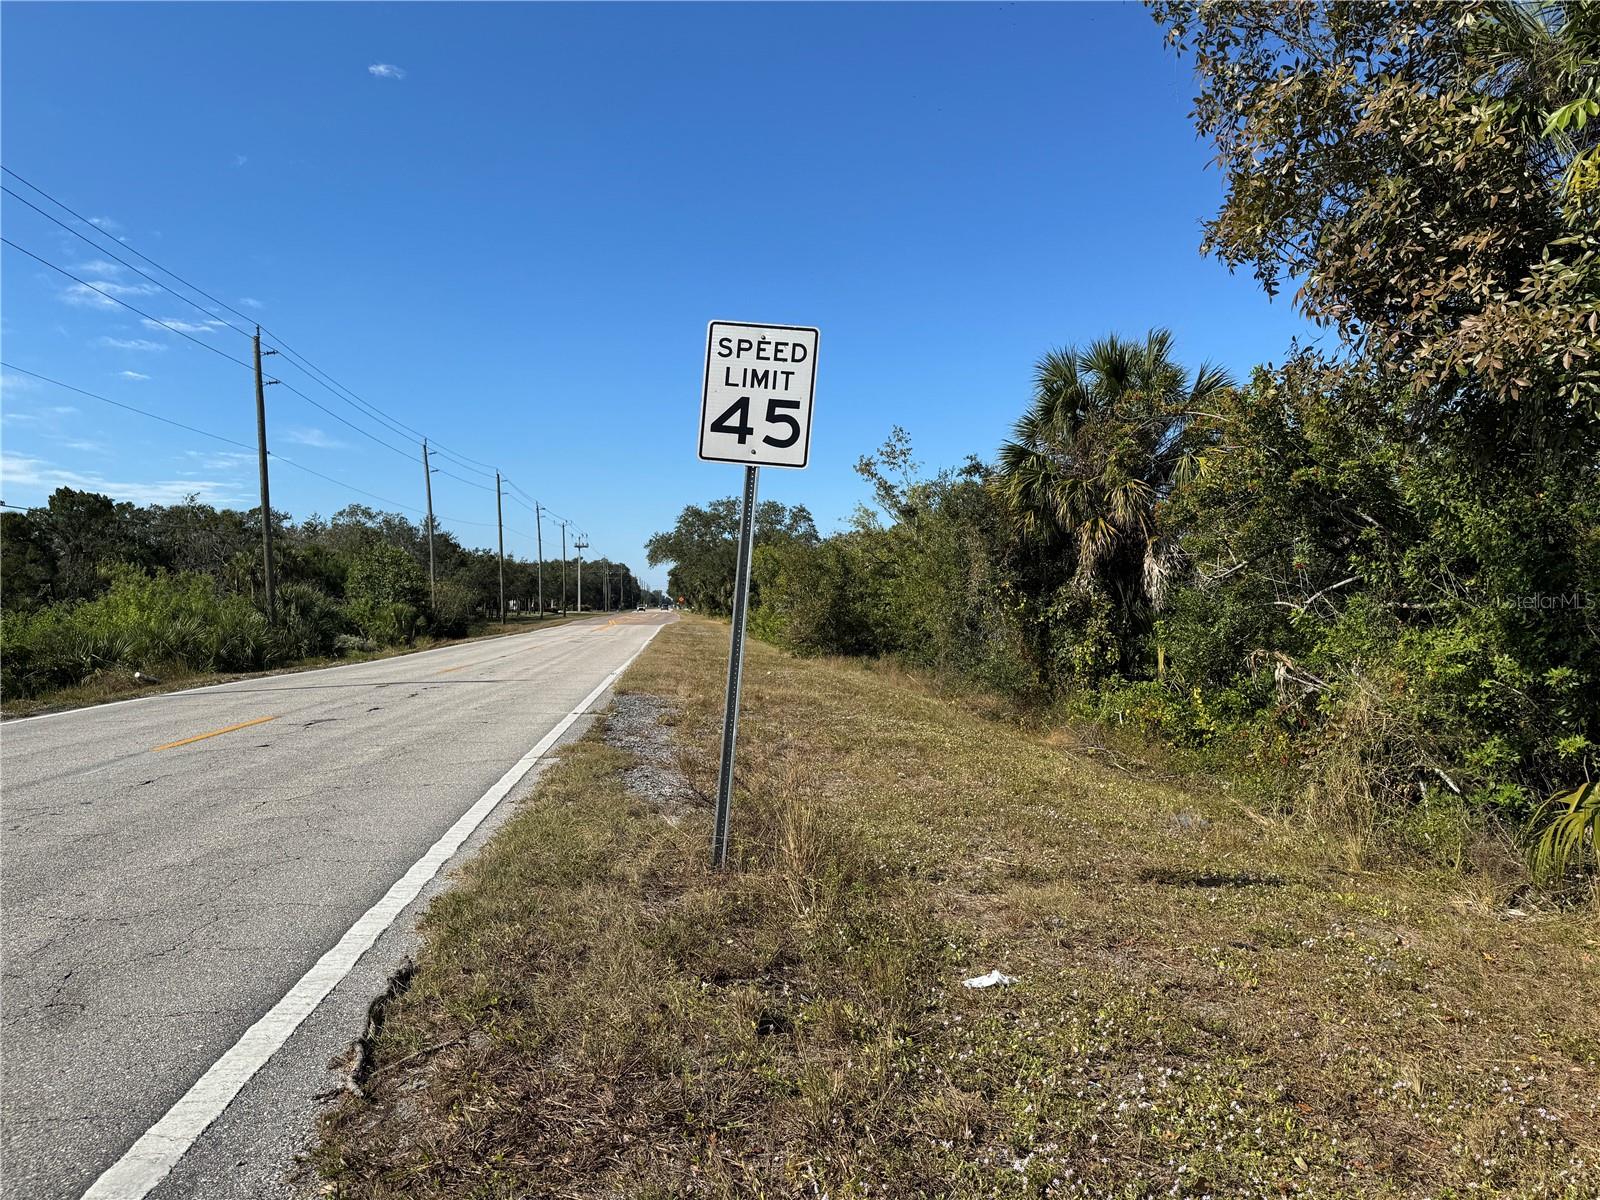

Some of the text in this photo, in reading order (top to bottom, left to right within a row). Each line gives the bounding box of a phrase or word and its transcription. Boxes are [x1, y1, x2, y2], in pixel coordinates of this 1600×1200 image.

[717, 337, 808, 363] SPEED
[724, 366, 795, 391] LIMIT
[710, 396, 801, 449] 45
